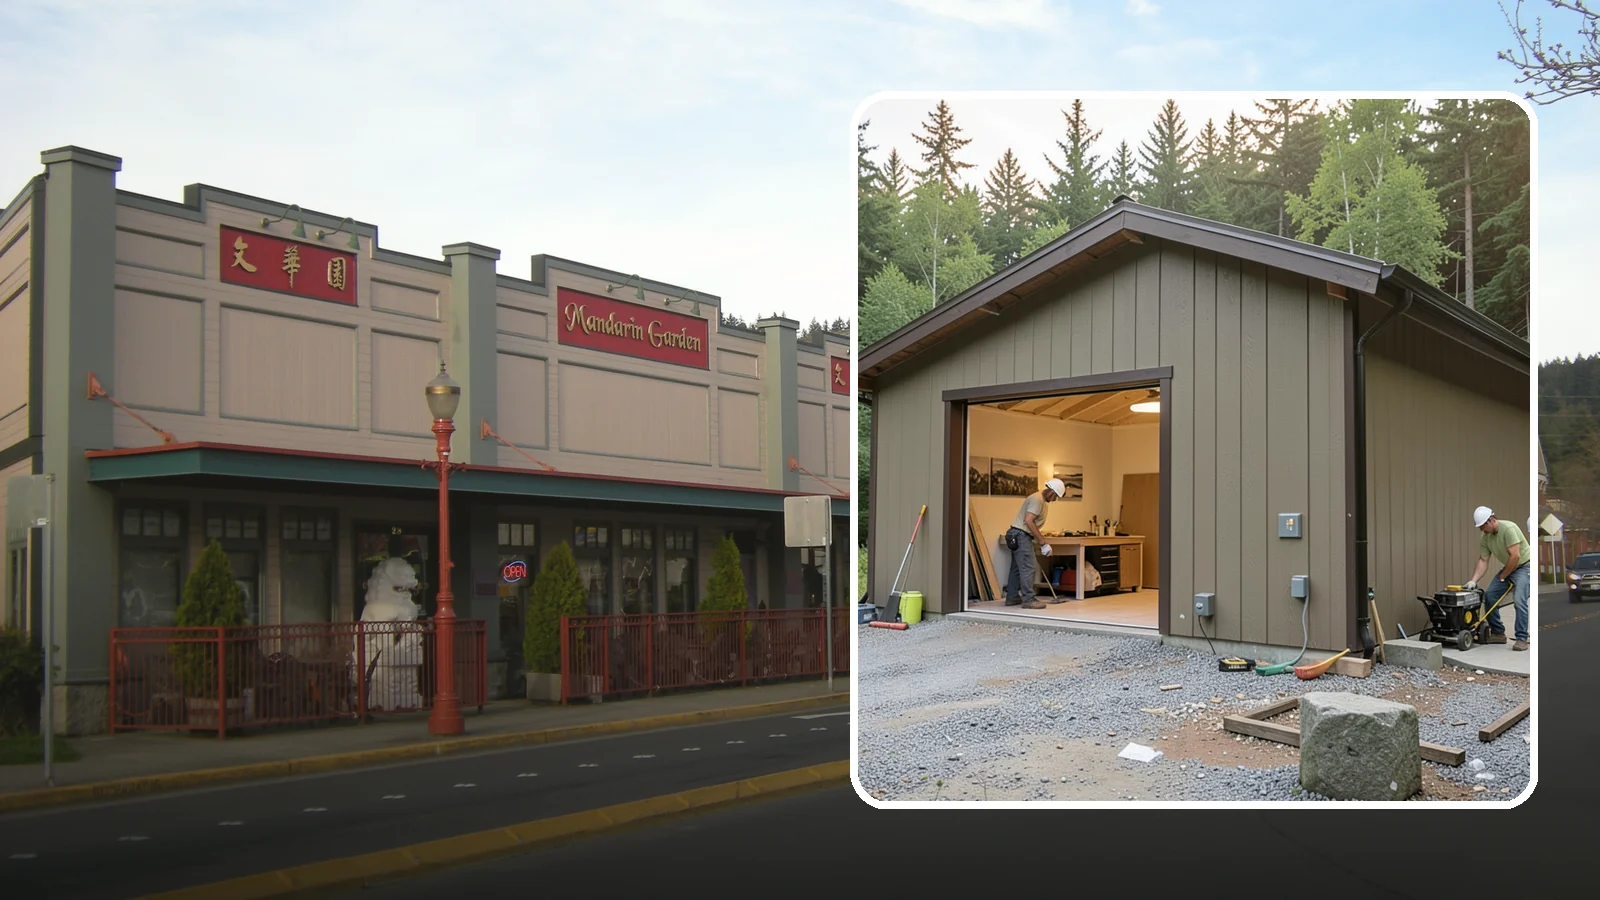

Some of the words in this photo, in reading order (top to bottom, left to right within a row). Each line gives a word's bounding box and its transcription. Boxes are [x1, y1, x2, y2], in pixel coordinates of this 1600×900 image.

[231, 236, 346, 290] 文華園
[565, 302, 643, 340] Mandarin
[648, 320, 701, 352] Garden
[835, 363, 846, 385] 文
[503, 565, 527, 578] OPEN
